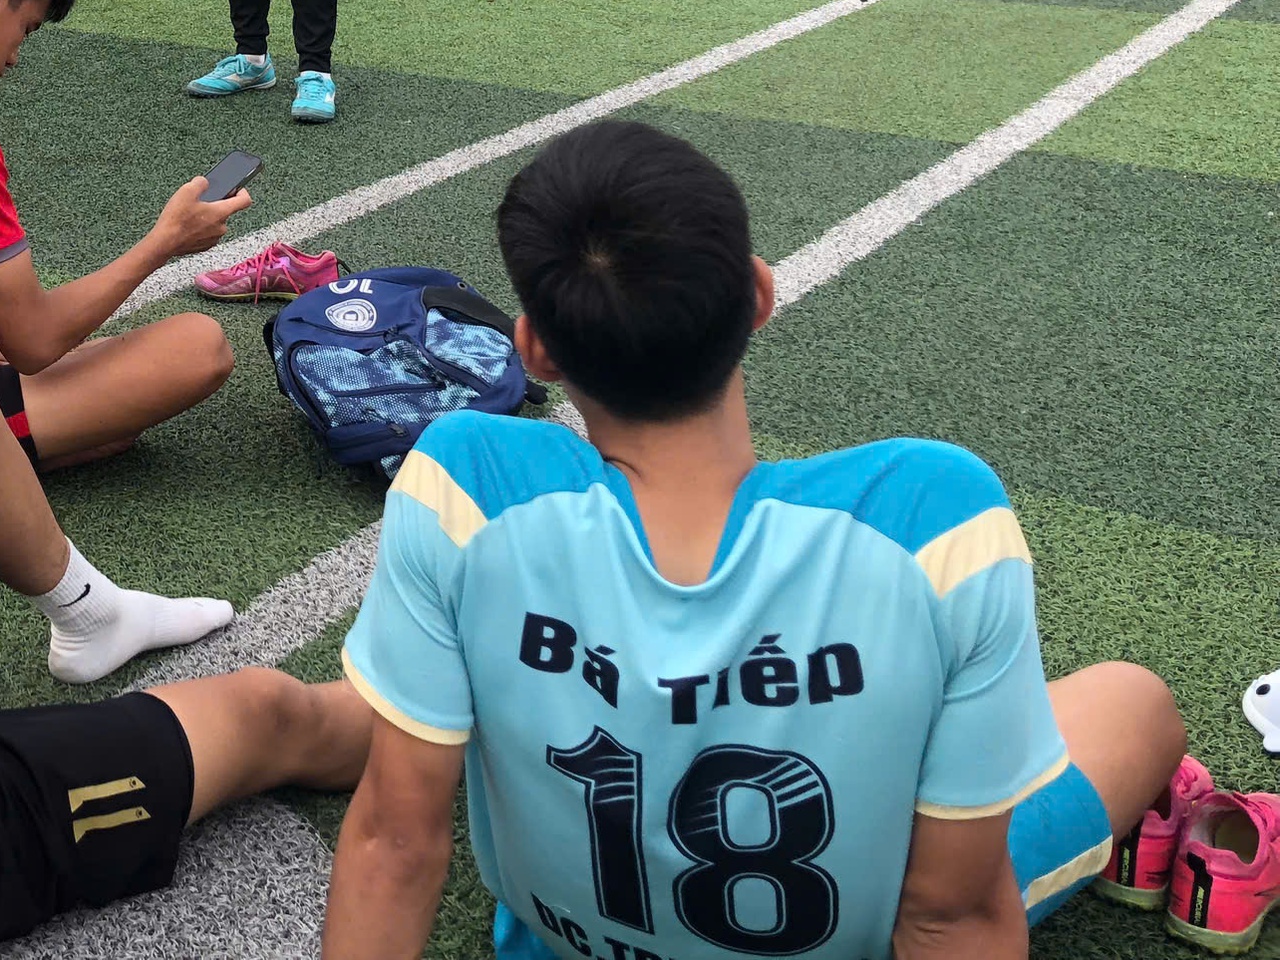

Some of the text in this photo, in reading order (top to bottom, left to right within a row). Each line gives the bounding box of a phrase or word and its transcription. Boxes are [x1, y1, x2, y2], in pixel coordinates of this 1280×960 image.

[519, 611, 865, 725] Bá Tiếp
[546, 725, 839, 956] 18
